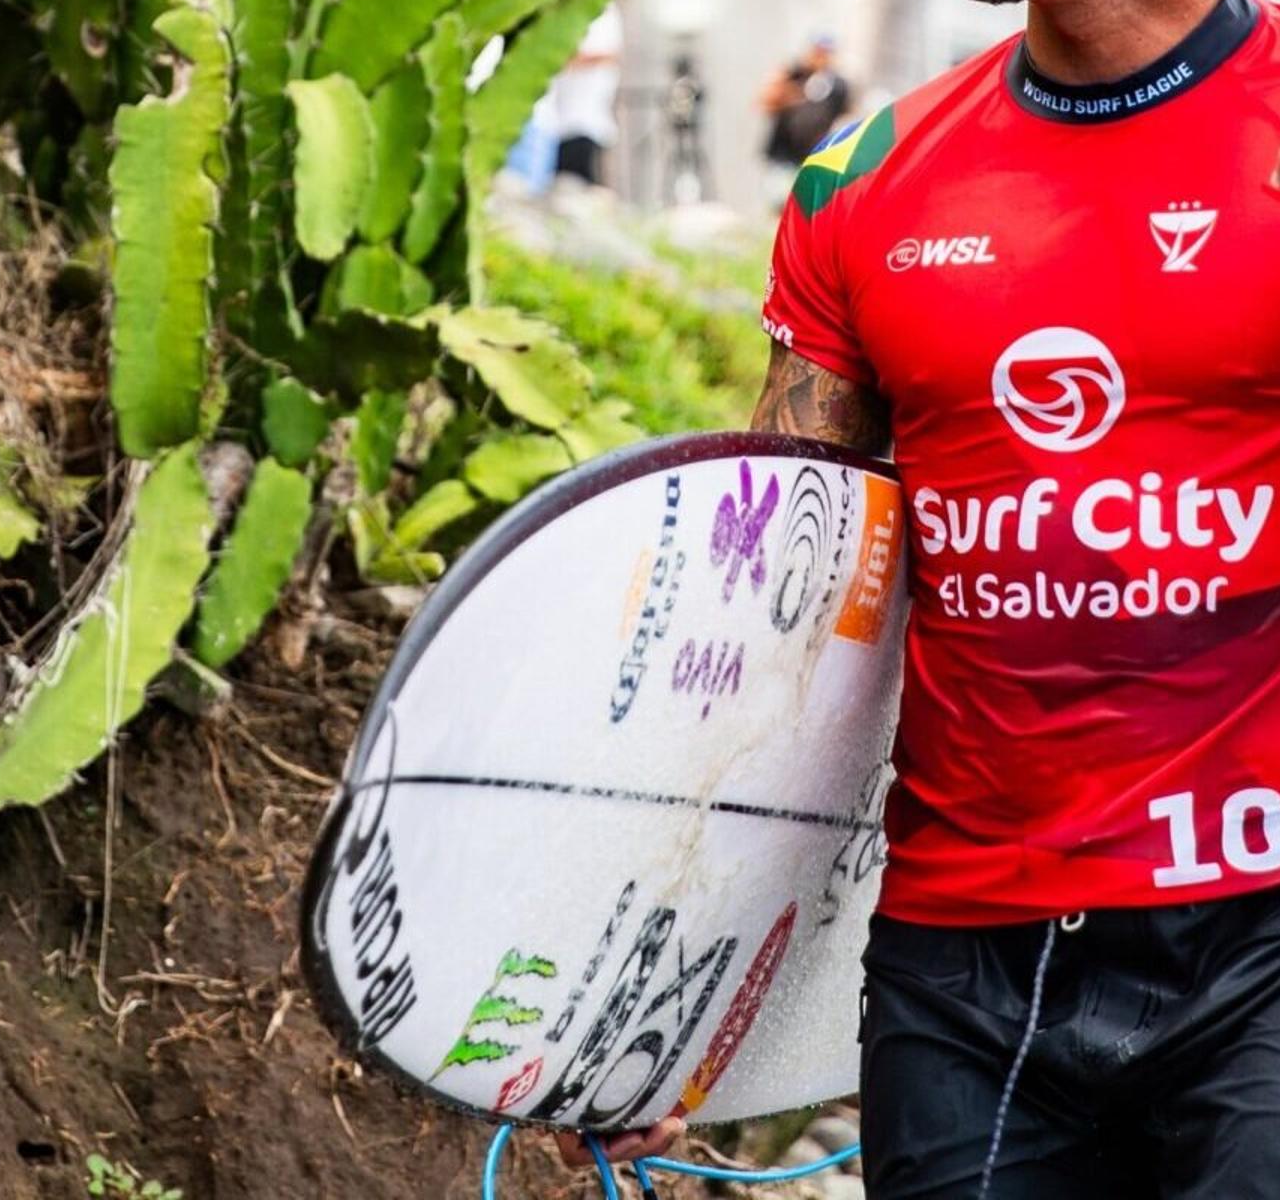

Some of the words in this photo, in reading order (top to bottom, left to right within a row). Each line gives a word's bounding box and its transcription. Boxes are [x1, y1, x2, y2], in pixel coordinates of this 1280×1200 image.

[1023, 77, 1071, 113] WORLD
[1075, 97, 1122, 115] SURF
[1125, 61, 1193, 108] LEAGUE
[921, 236, 996, 267] WSL
[914, 477, 1059, 554] Surf
[1072, 471, 1274, 563] City
[860, 508, 896, 602] JBL
[975, 568, 1228, 619] Salvador
